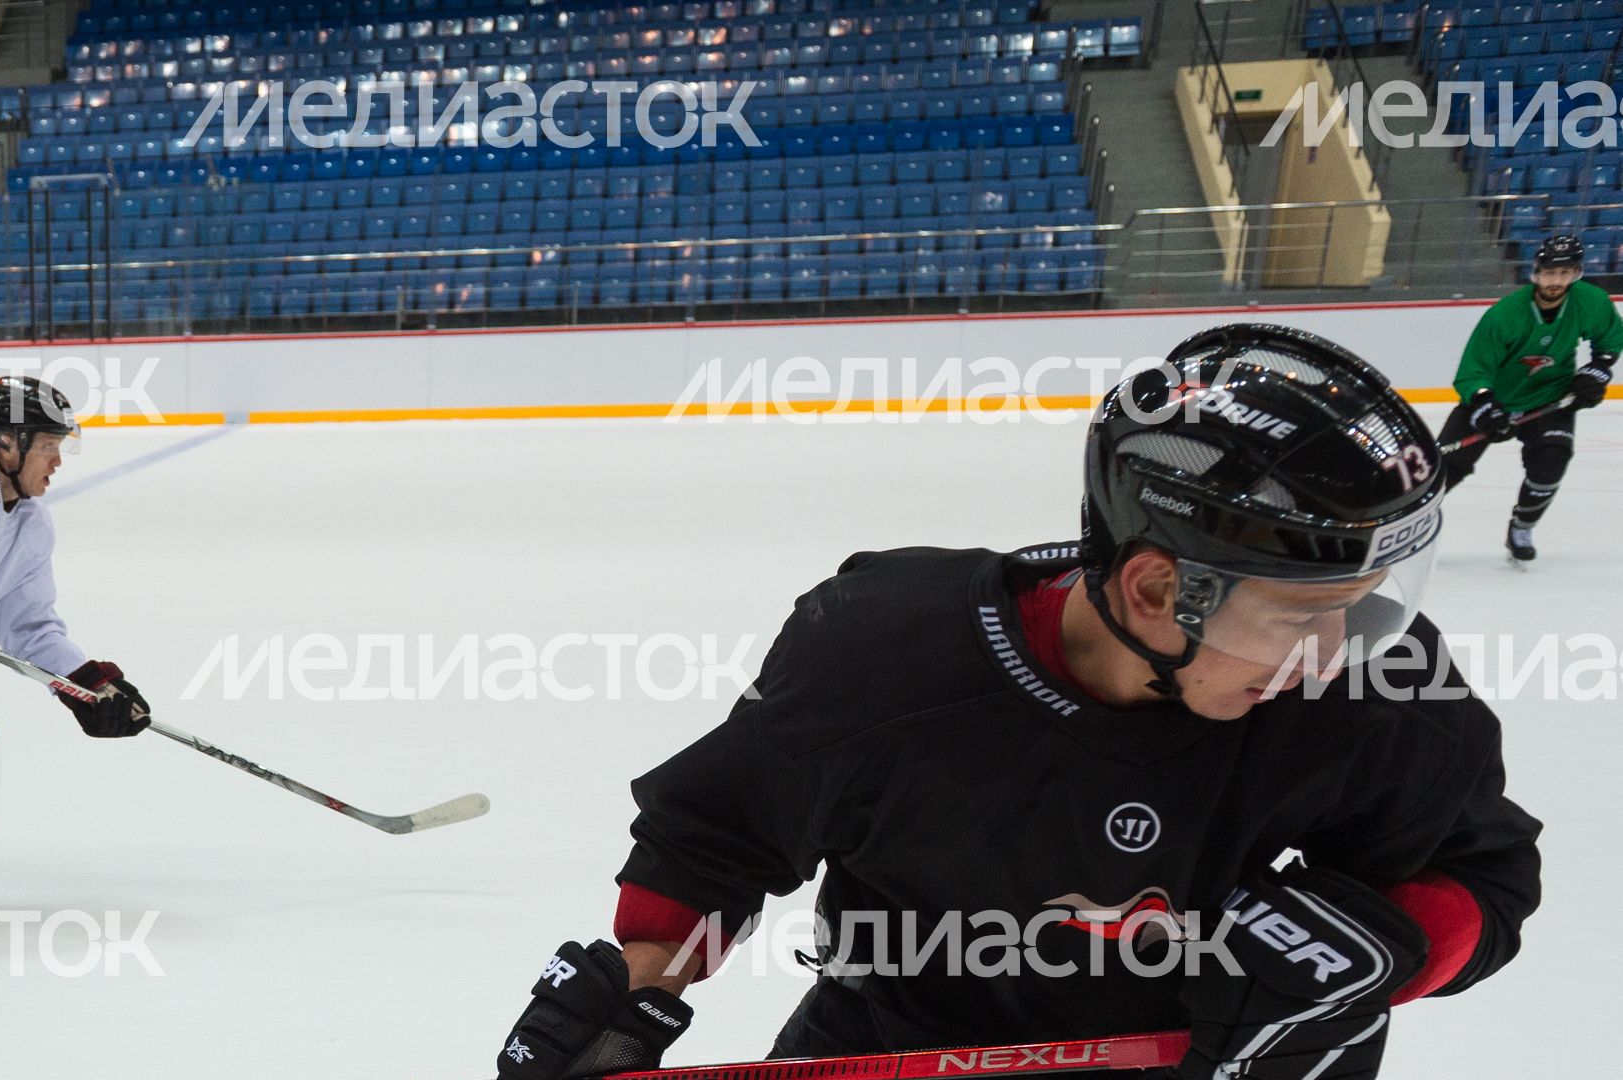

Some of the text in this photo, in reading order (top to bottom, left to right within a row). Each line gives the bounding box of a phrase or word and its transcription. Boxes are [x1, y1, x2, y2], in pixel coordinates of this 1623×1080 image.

[1381, 444, 1432, 492] 73
[1139, 486, 1195, 518] Reebok
[1377, 512, 1436, 552] СОГА
[978, 606, 1081, 717] WARRIOR
